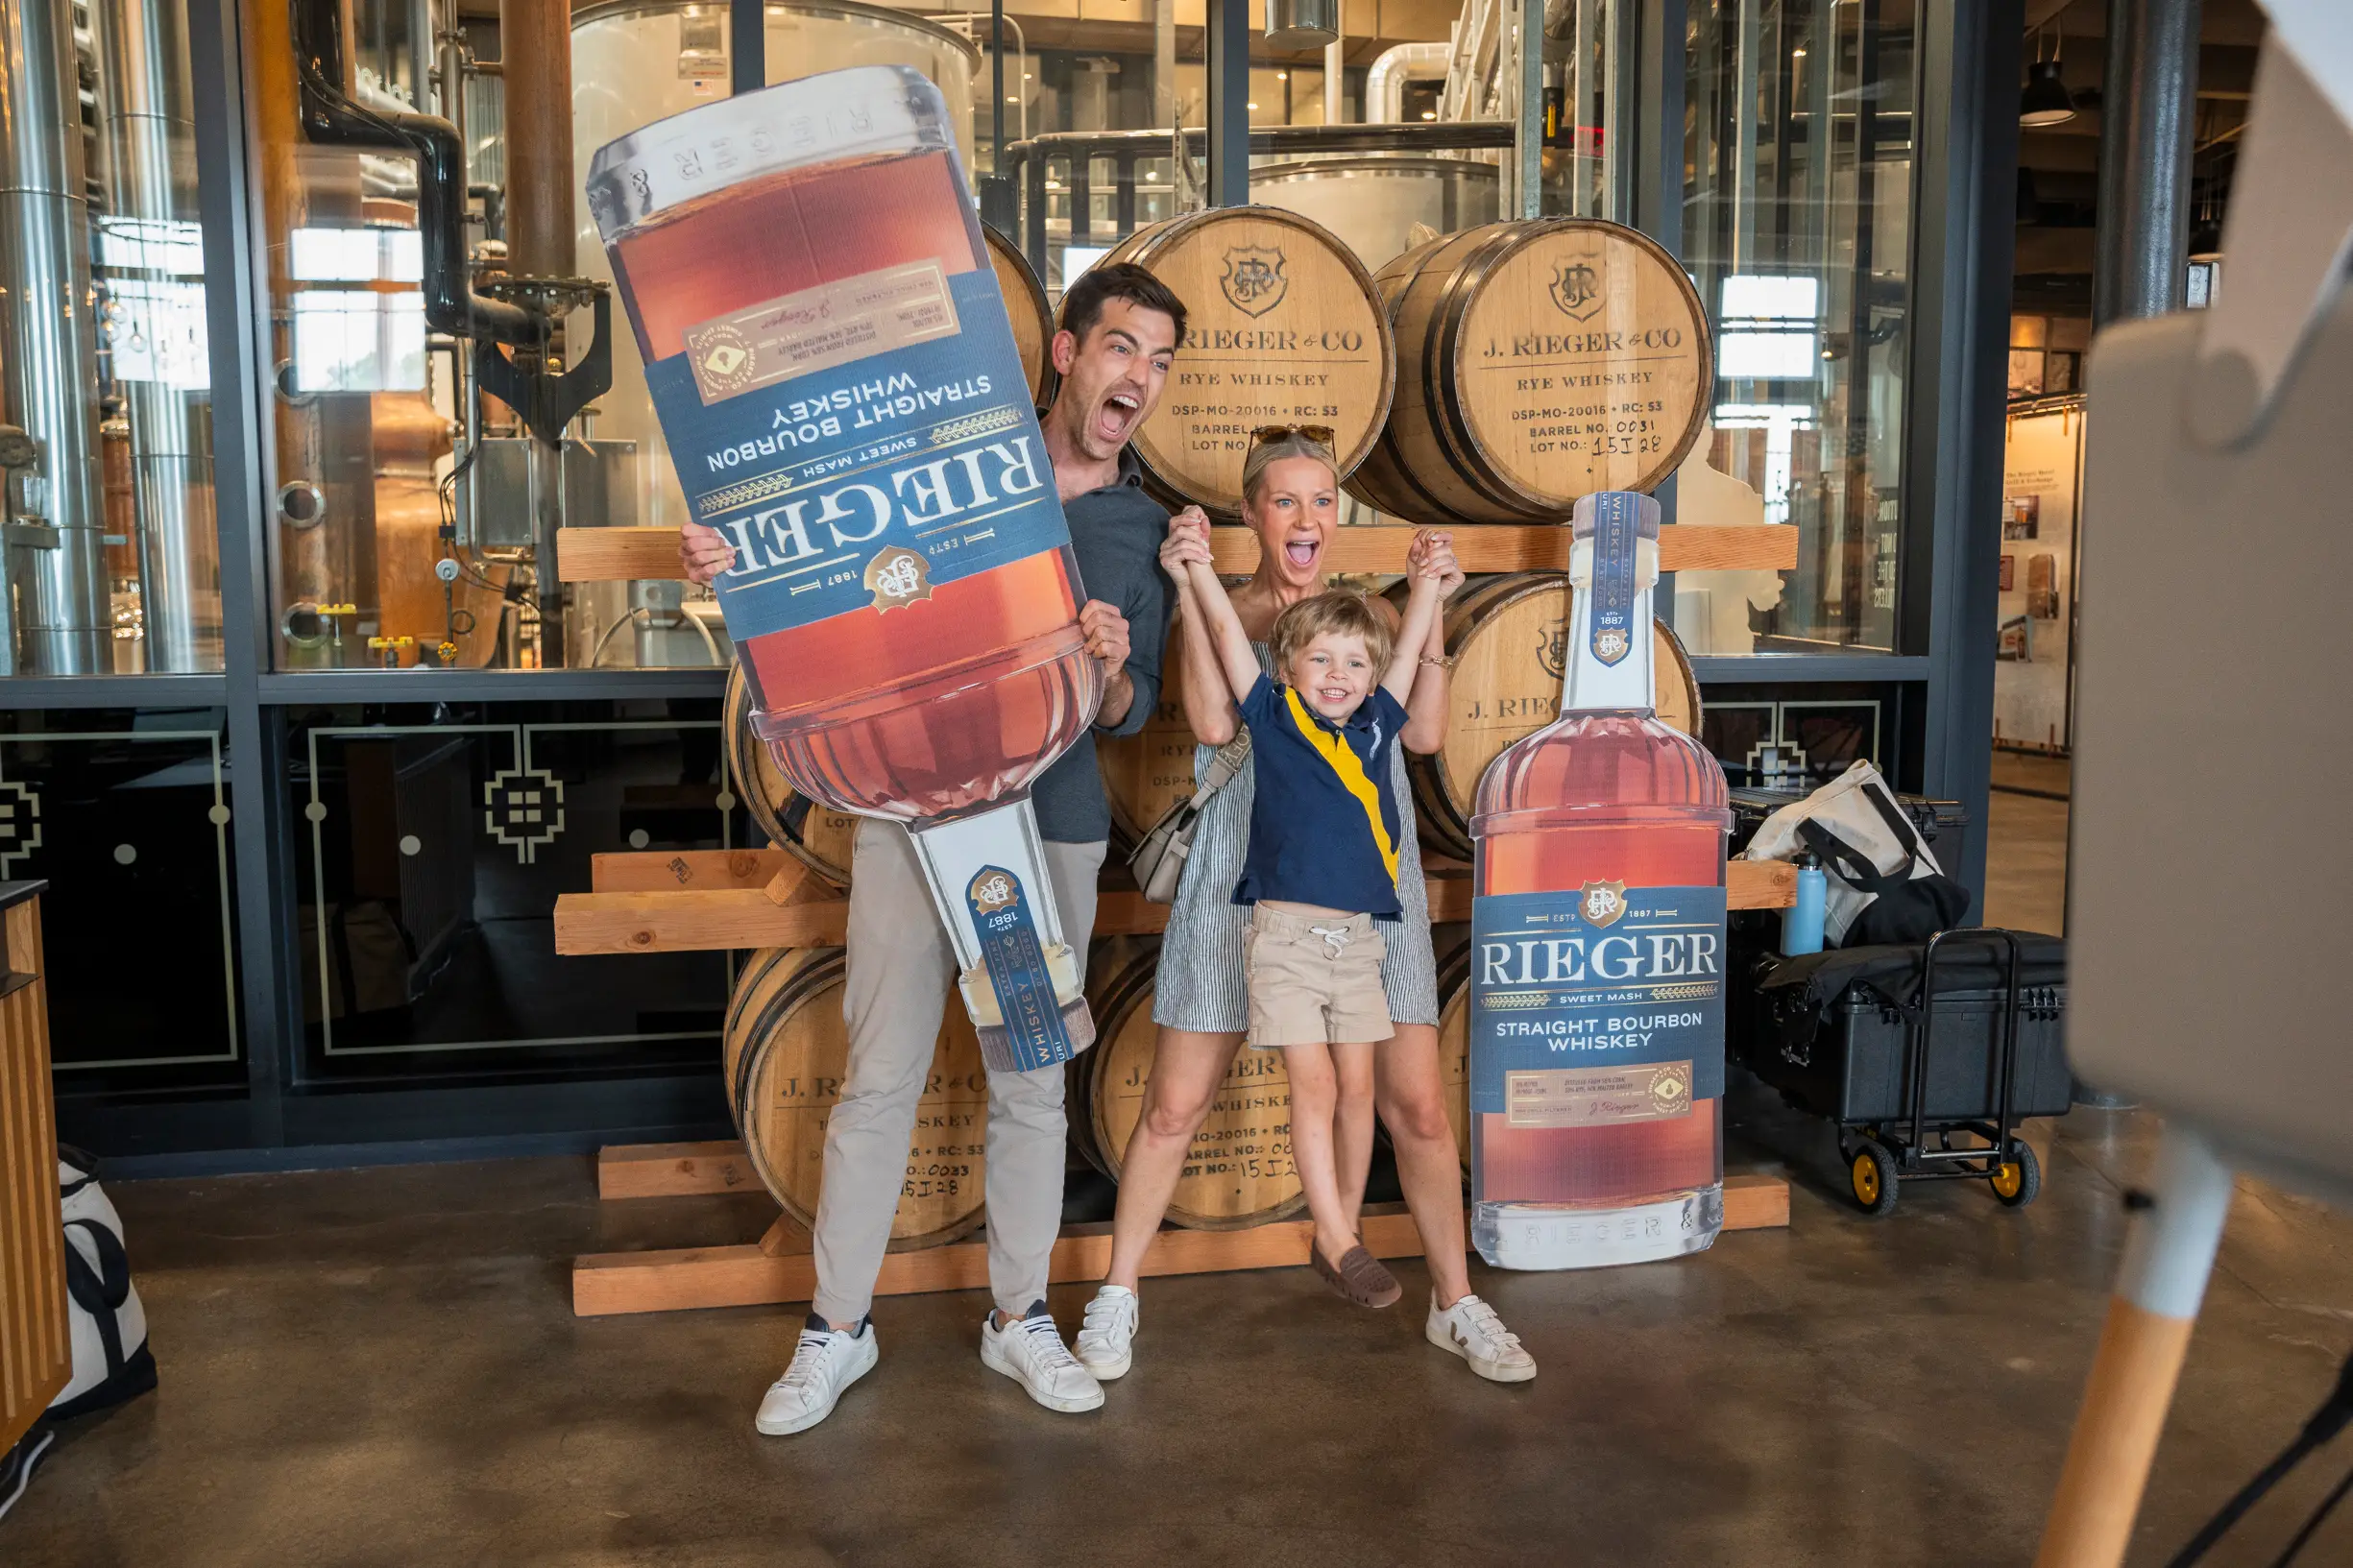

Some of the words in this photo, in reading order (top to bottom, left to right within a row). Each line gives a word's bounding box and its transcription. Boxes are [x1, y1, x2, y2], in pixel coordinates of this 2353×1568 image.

[1178, 328, 1297, 350] RIEGER
[1303, 335, 1318, 347] &
[1321, 330, 1363, 351] CO
[1483, 338, 1504, 358] J.
[1512, 331, 1623, 356] RIEGER
[1628, 333, 1642, 347] &
[1644, 327, 1682, 350] CO
[1179, 373, 1220, 385] RYE
[1230, 374, 1329, 386] WHISKEY
[1516, 377, 1553, 391] RYE
[1562, 372, 1653, 388] WHISKEY
[771, 372, 918, 429] WHISKEY
[854, 374, 992, 428] STRAIGHT
[1172, 405, 1276, 417] DSP-MO-20016
[1294, 406, 1318, 417] RC:
[1512, 404, 1607, 421] DSP-MO-20016
[1622, 402, 1644, 414] RC:
[1192, 423, 1248, 435] BARREL
[1530, 423, 1581, 438] BARREL
[707, 416, 842, 472] BOURBON
[859, 437, 917, 462] SWEET
[1192, 441, 1219, 450] LOT
[1225, 441, 1246, 450] NO
[1530, 442, 1555, 454] LOT
[803, 455, 853, 478] MASH
[1610, 495, 1622, 567] WHISKEY
[828, 569, 858, 587] 1887
[1600, 616, 1624, 625] 1887
[826, 817, 854, 829] LOT
[988, 911, 1019, 929] 1887
[1629, 909, 1651, 918] 1887
[1480, 933, 1718, 985] RIEGER
[1560, 994, 1603, 1003] SWEET
[1607, 992, 1642, 1001] MASH
[1018, 982, 1052, 1063] WHISKEY
[1496, 1019, 1599, 1037] STRAIGHT
[1608, 1012, 1702, 1032] BOURBON
[1548, 1032, 1653, 1051] WHISKEY
[782, 1078, 806, 1098] J.
[967, 1073, 987, 1094] C
[1212, 1095, 1291, 1113] WHISKE
[918, 1115, 975, 1128] SKEY
[937, 1146, 962, 1157] RC:
[967, 1145, 984, 1156] 53
[1186, 1148, 1229, 1161] ARREL
[928, 1164, 970, 1177] 0033
